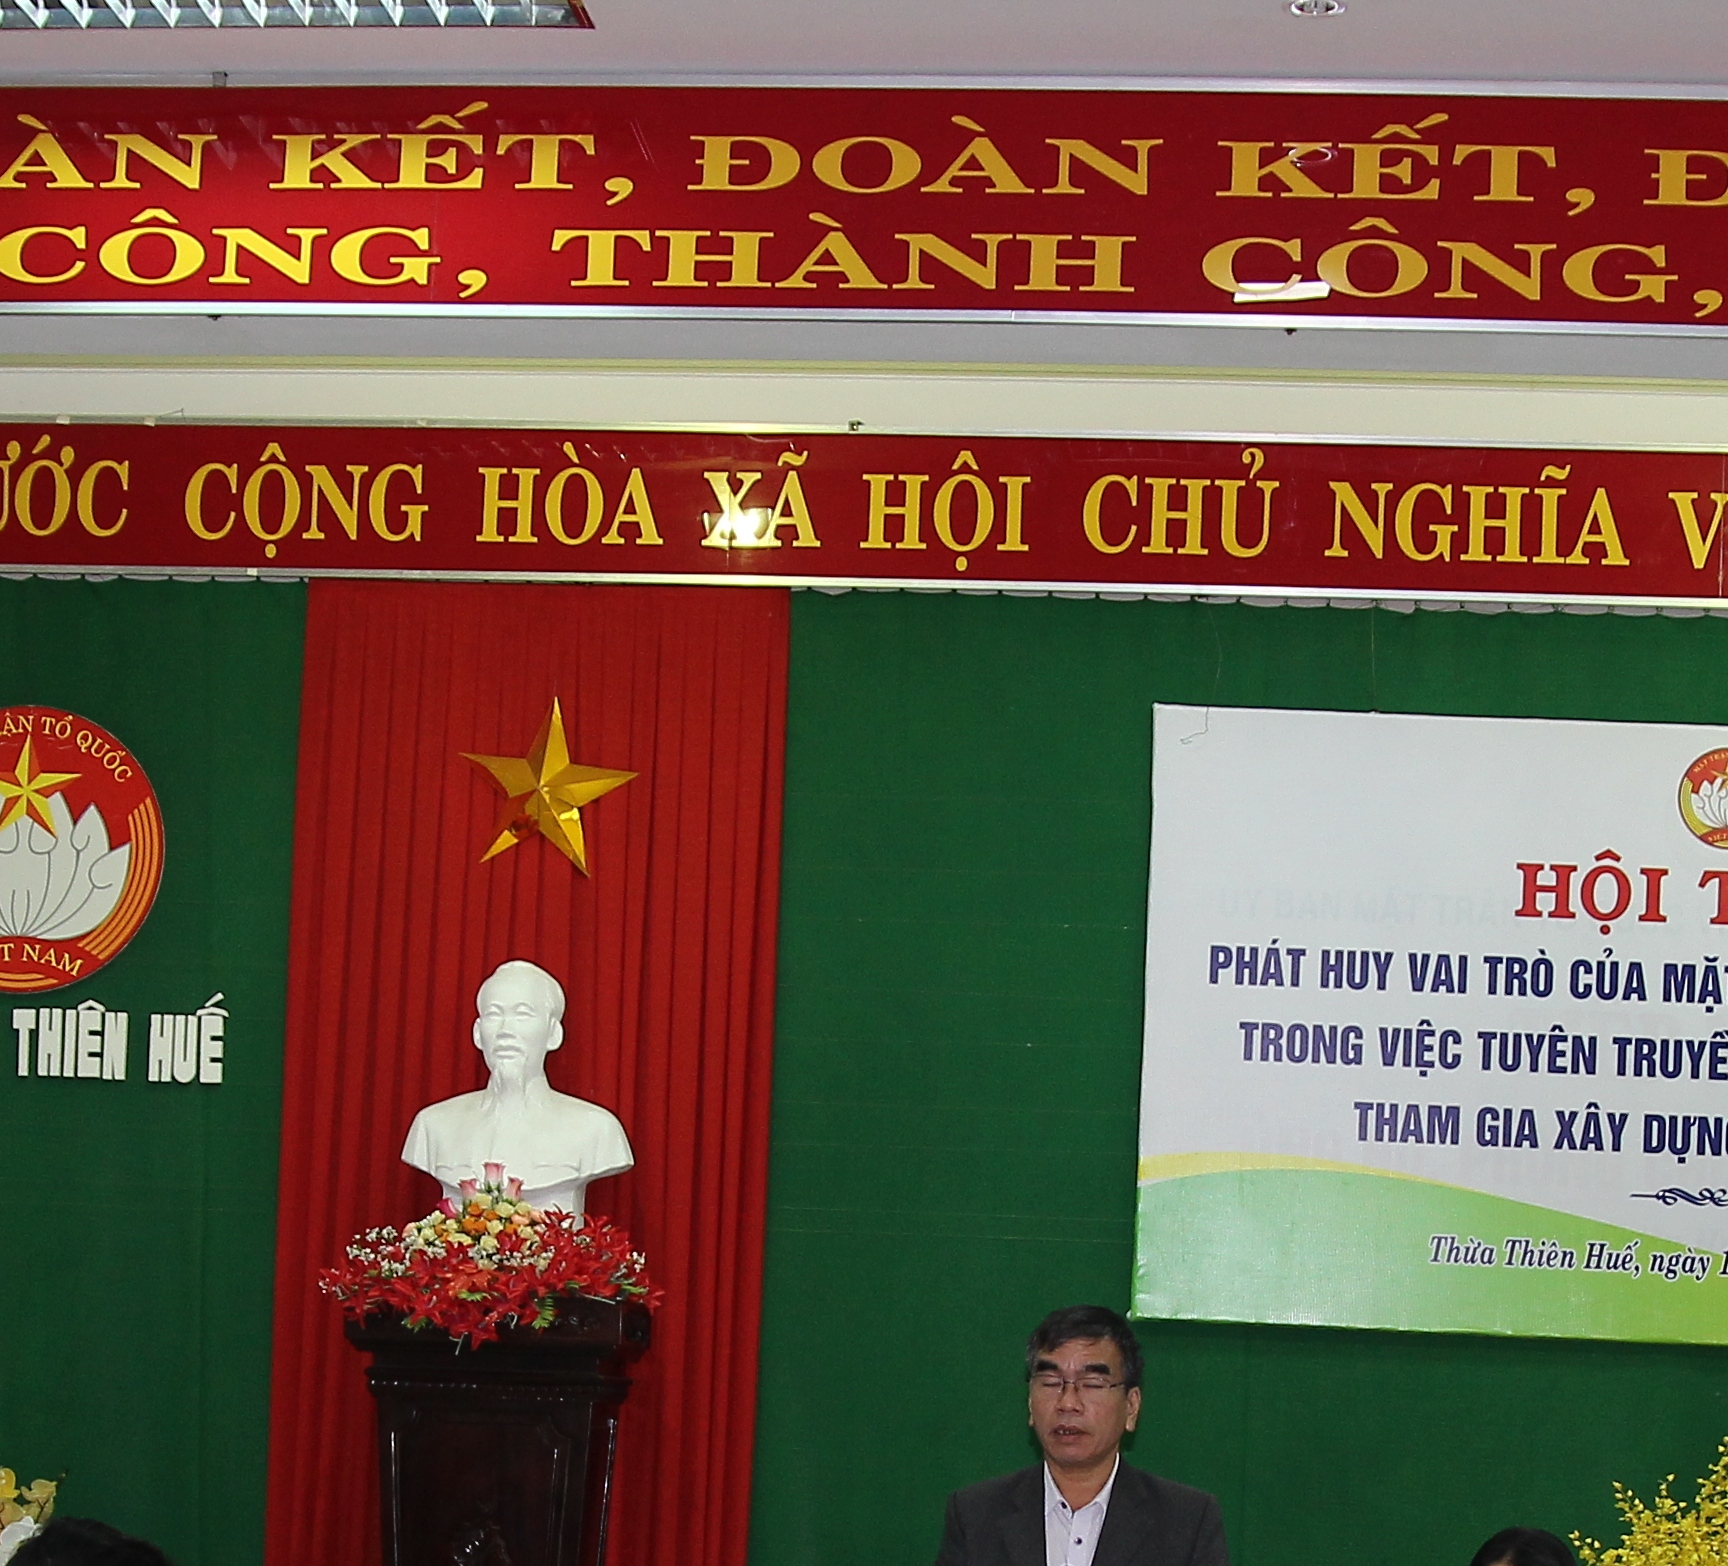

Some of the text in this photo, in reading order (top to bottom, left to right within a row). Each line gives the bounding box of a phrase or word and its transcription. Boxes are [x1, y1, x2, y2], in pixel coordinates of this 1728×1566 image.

[270, 102, 633, 205] KẾT,
[688, 116, 1163, 194] ĐOÀN
[1217, 114, 1594, 215] KẾT,
[552, 215, 1136, 292] THÀNH
[1203, 217, 1722, 317] CÔNG,
[185, 443, 428, 558] CỘNG
[476, 442, 663, 545] HÒA
[702, 450, 821, 548] XÃ
[860, 451, 1031, 571] HỘI
[1083, 448, 1279, 557] CHỦ
[1325, 466, 1629, 565] NGHĨA
[41, 715, 73, 739] TỔ
[76, 729, 132, 782] QUỐC
[1515, 848, 1669, 936] HỘI
[20, 943, 84, 977] NAM
[1210, 939, 1306, 987] PHÁT
[1321, 950, 1393, 990] HUY
[1409, 953, 1467, 994] VAI
[1484, 949, 1553, 997] TRÒ
[1570, 948, 1647, 1001] CỦA
[13, 1000, 127, 1079] THIÊN
[149, 993, 228, 1083] HUẾ
[1240, 1022, 1363, 1065] TRONG
[1379, 1019, 1461, 1077] VIỆC
[1478, 1025, 1597, 1075] TUYÊN
[1354, 1102, 1460, 1145] THAM
[1477, 1107, 1539, 1148] GIA
[1554, 1102, 1628, 1152] XÂY
[1431, 1236, 1494, 1264] Thừa
[1505, 1240, 1575, 1268] Thiên
[1584, 1241, 1639, 1275] Huế,
[1650, 1248, 1710, 1280] ngày
